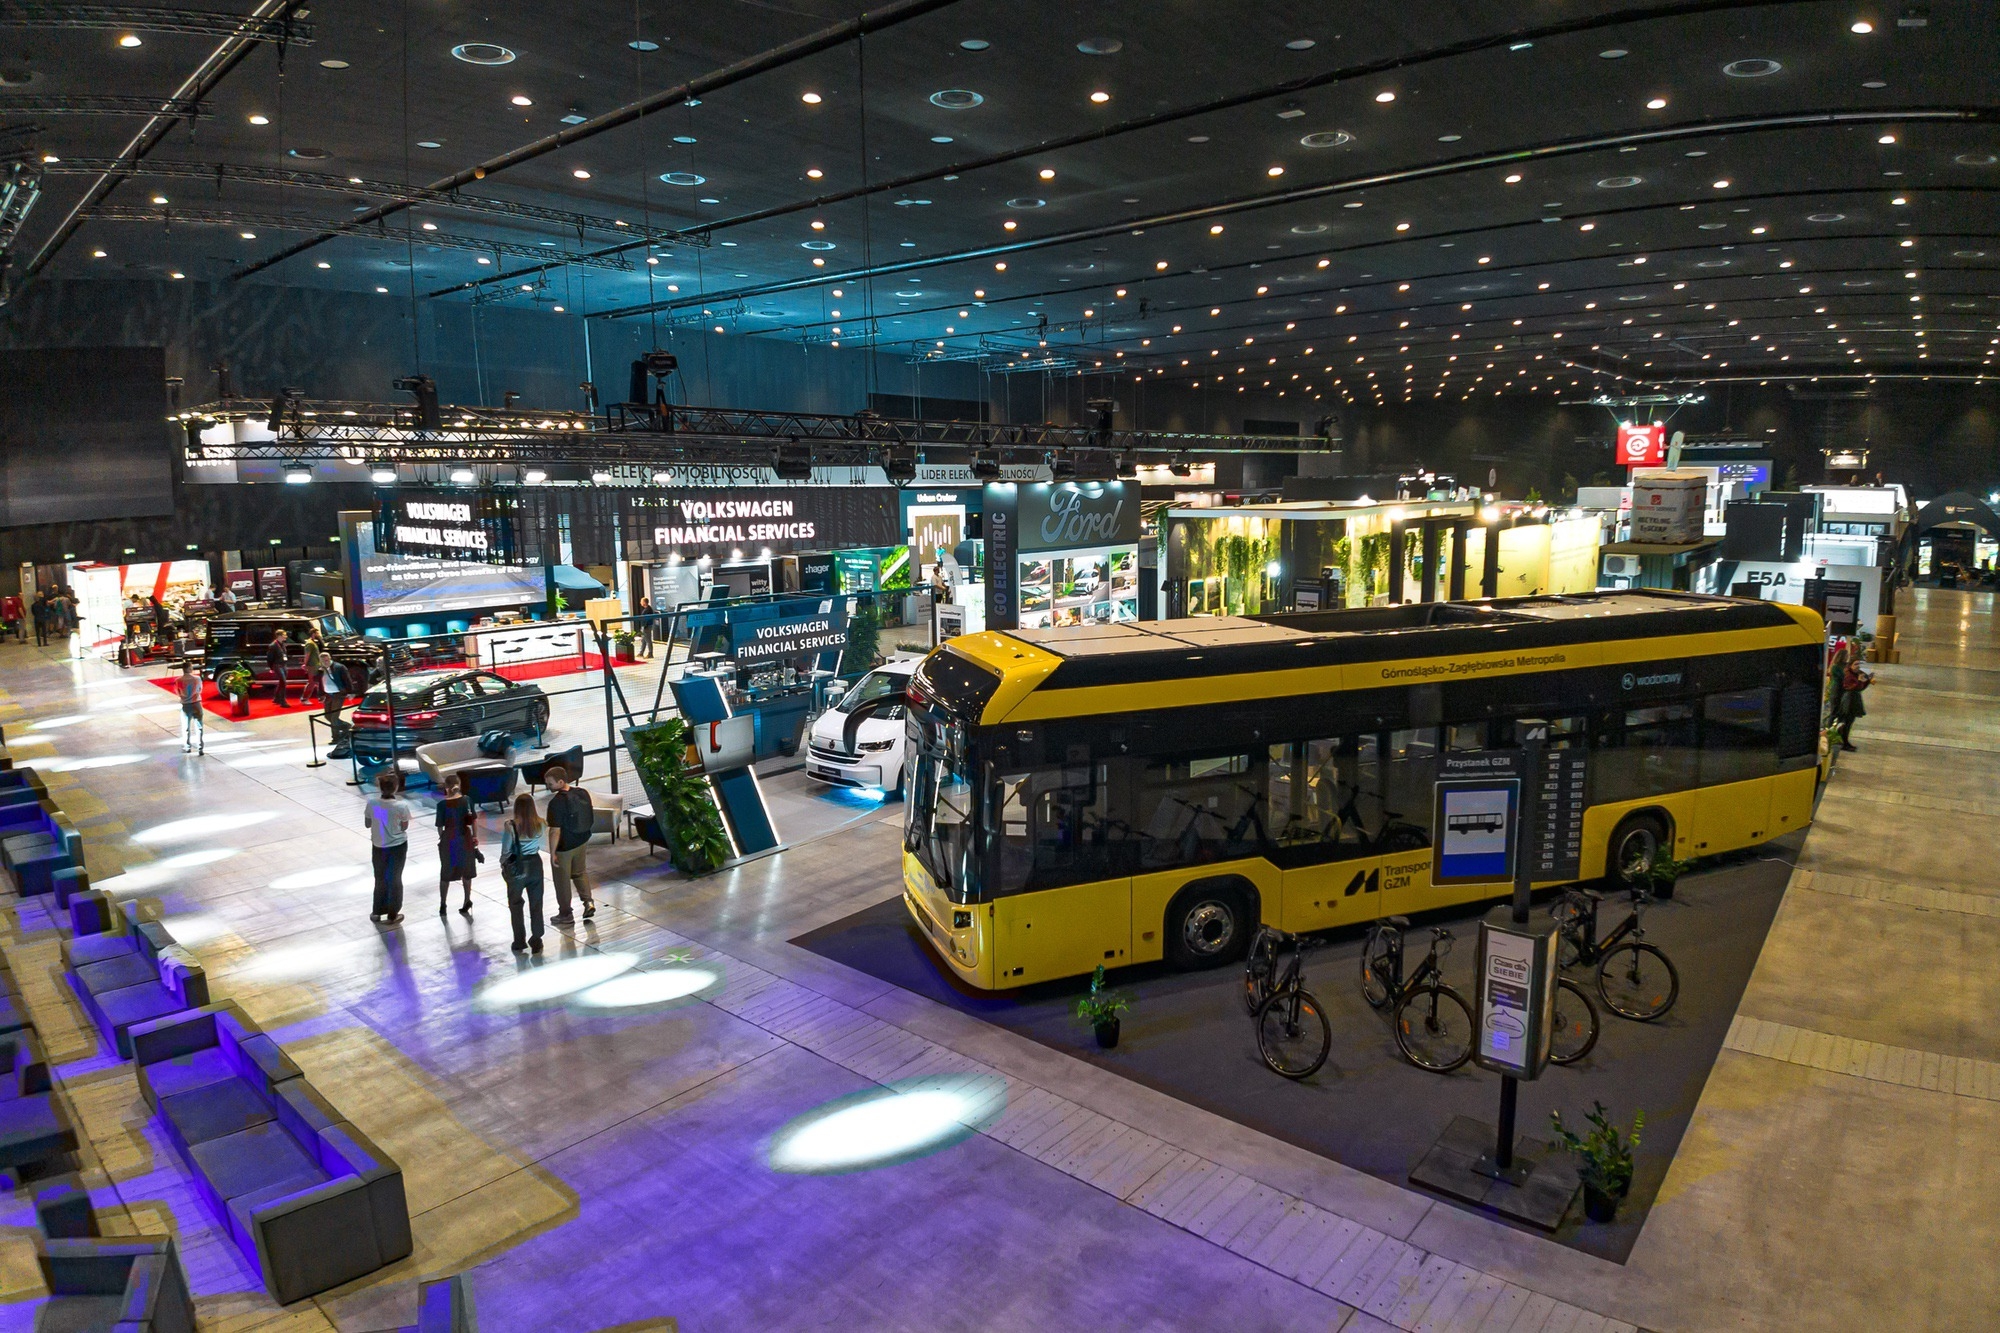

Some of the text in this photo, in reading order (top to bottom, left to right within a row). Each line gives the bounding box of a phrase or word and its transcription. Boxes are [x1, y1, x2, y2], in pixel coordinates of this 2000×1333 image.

[921, 467, 1034, 480] LIDER ELEKTBILNOŚCI
[406, 503, 471, 521] VOLKSWAGEN
[681, 501, 793, 519] VOLKSWAGEN
[1040, 486, 1124, 543] Ford
[396, 526, 488, 549] FINANCIAL SERVICES
[654, 522, 815, 546] FINANCIAL SERVICES
[442, 560, 460, 568] and
[992, 512, 1007, 616] GO ELECTRIC
[403, 571, 419, 580] the
[420, 571, 436, 581] top
[437, 569, 460, 579] three
[461, 567, 496, 577] benefits
[497, 566, 507, 575] of
[756, 620, 829, 639] VOLKSWAGEN
[737, 633, 846, 659] FINANCIAL SERVICES
[1381, 654, 1566, 679] Górnośląsko-Zagłębiowska Metropolia
[1637, 673, 1682, 686] wodorowy
[1446, 757, 1511, 769] Przystanek GZM
[1385, 861, 1432, 877] Transpor
[1384, 876, 1411, 890] GZM
[1493, 966, 1524, 980] SIEBIE
[1494, 958, 1527, 972] Czas dla
